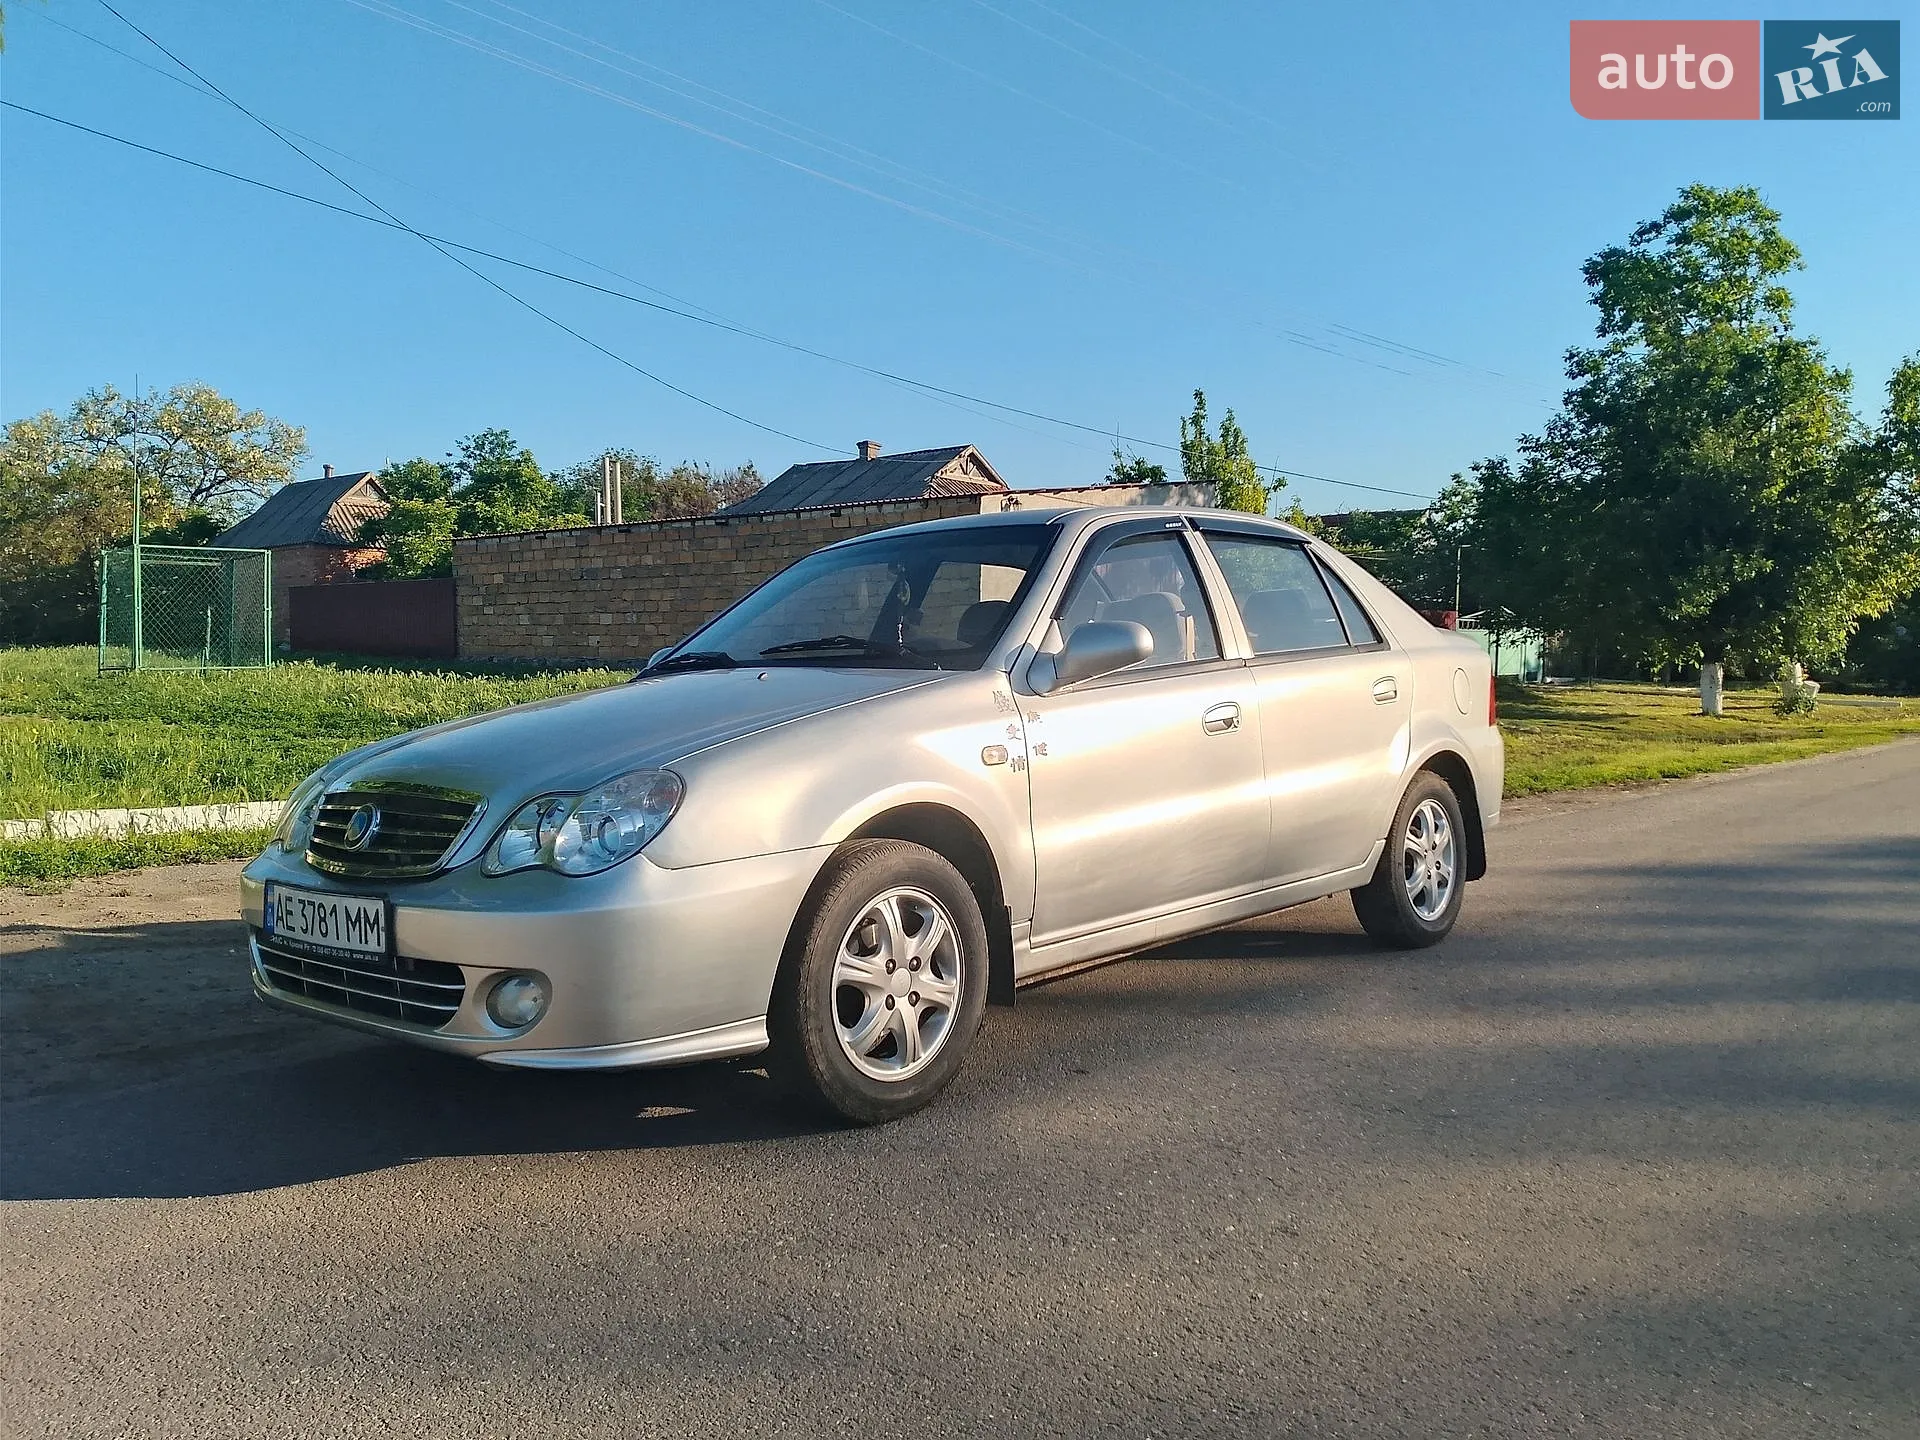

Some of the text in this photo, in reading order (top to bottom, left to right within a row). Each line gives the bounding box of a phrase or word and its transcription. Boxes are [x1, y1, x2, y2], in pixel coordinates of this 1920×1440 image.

[275, 892, 296, 932] AE
[297, 898, 340, 941] 3781
[344, 904, 381, 947] MM
